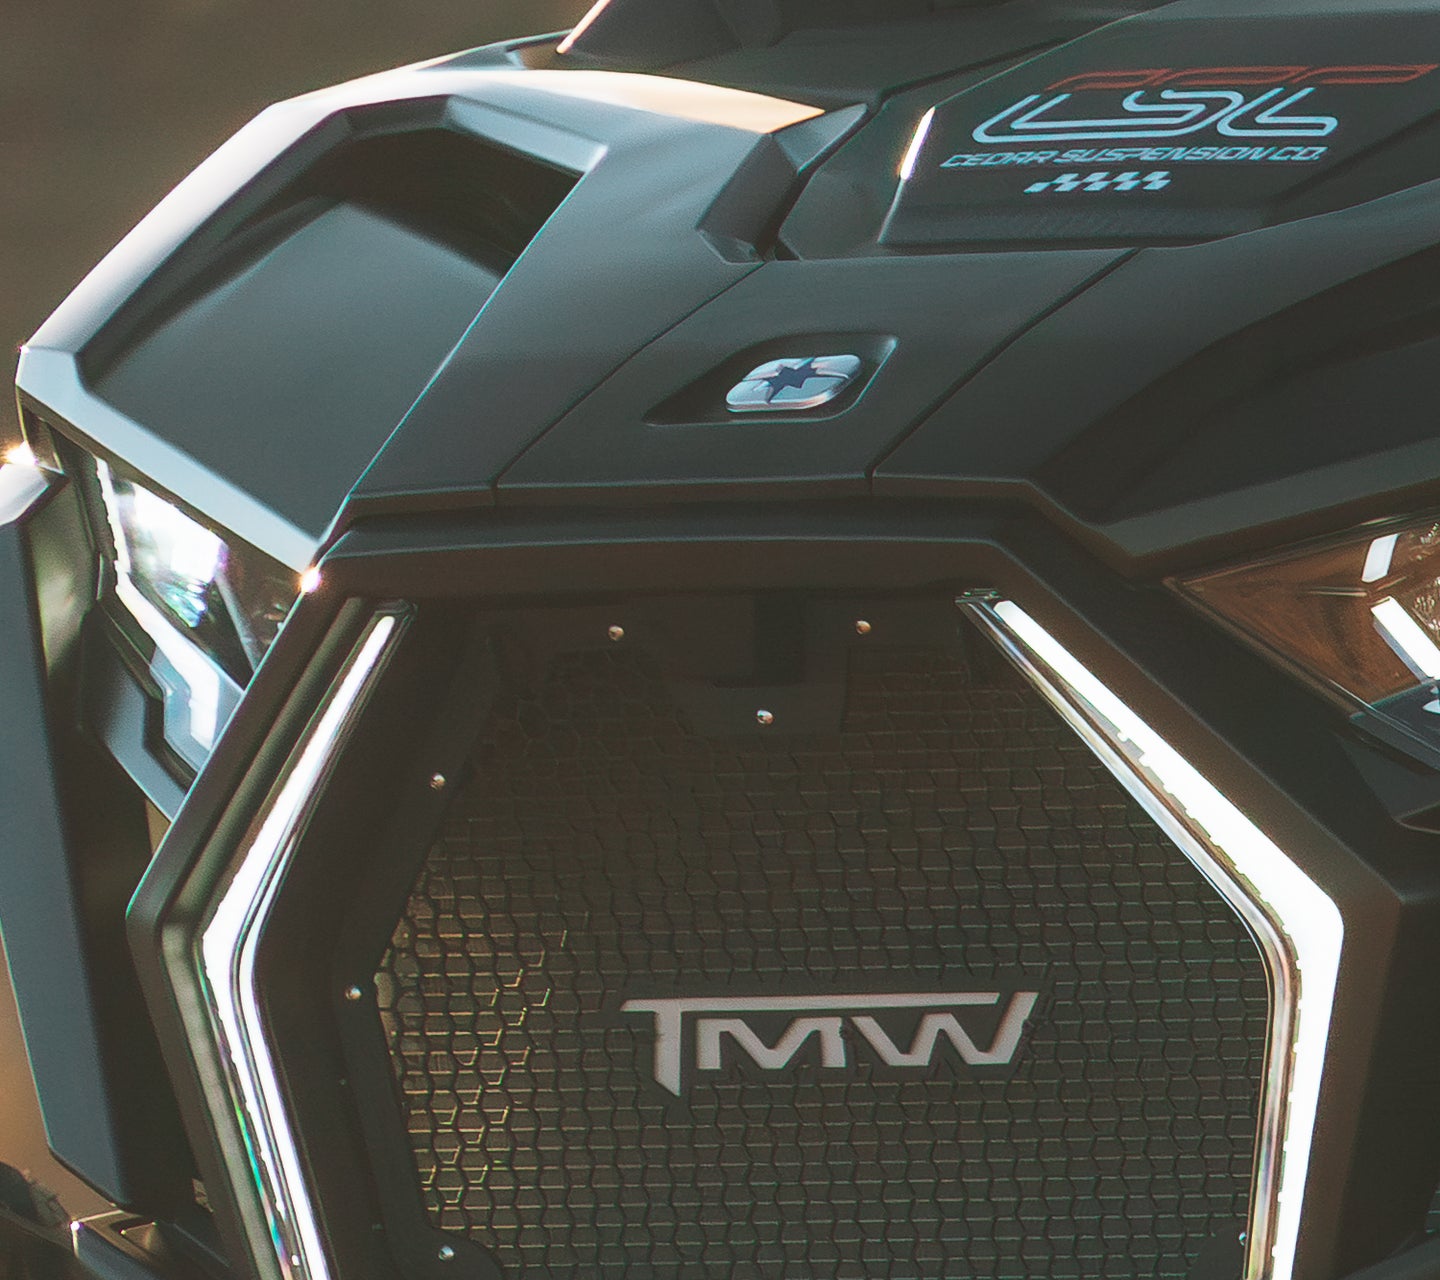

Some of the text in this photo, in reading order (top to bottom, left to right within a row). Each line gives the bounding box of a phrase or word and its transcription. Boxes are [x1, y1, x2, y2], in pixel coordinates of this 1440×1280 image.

[940, 149, 1058, 168] CEDAR
[1054, 146, 1273, 164] SUSPENSION
[620, 992, 1039, 1097] TMW
